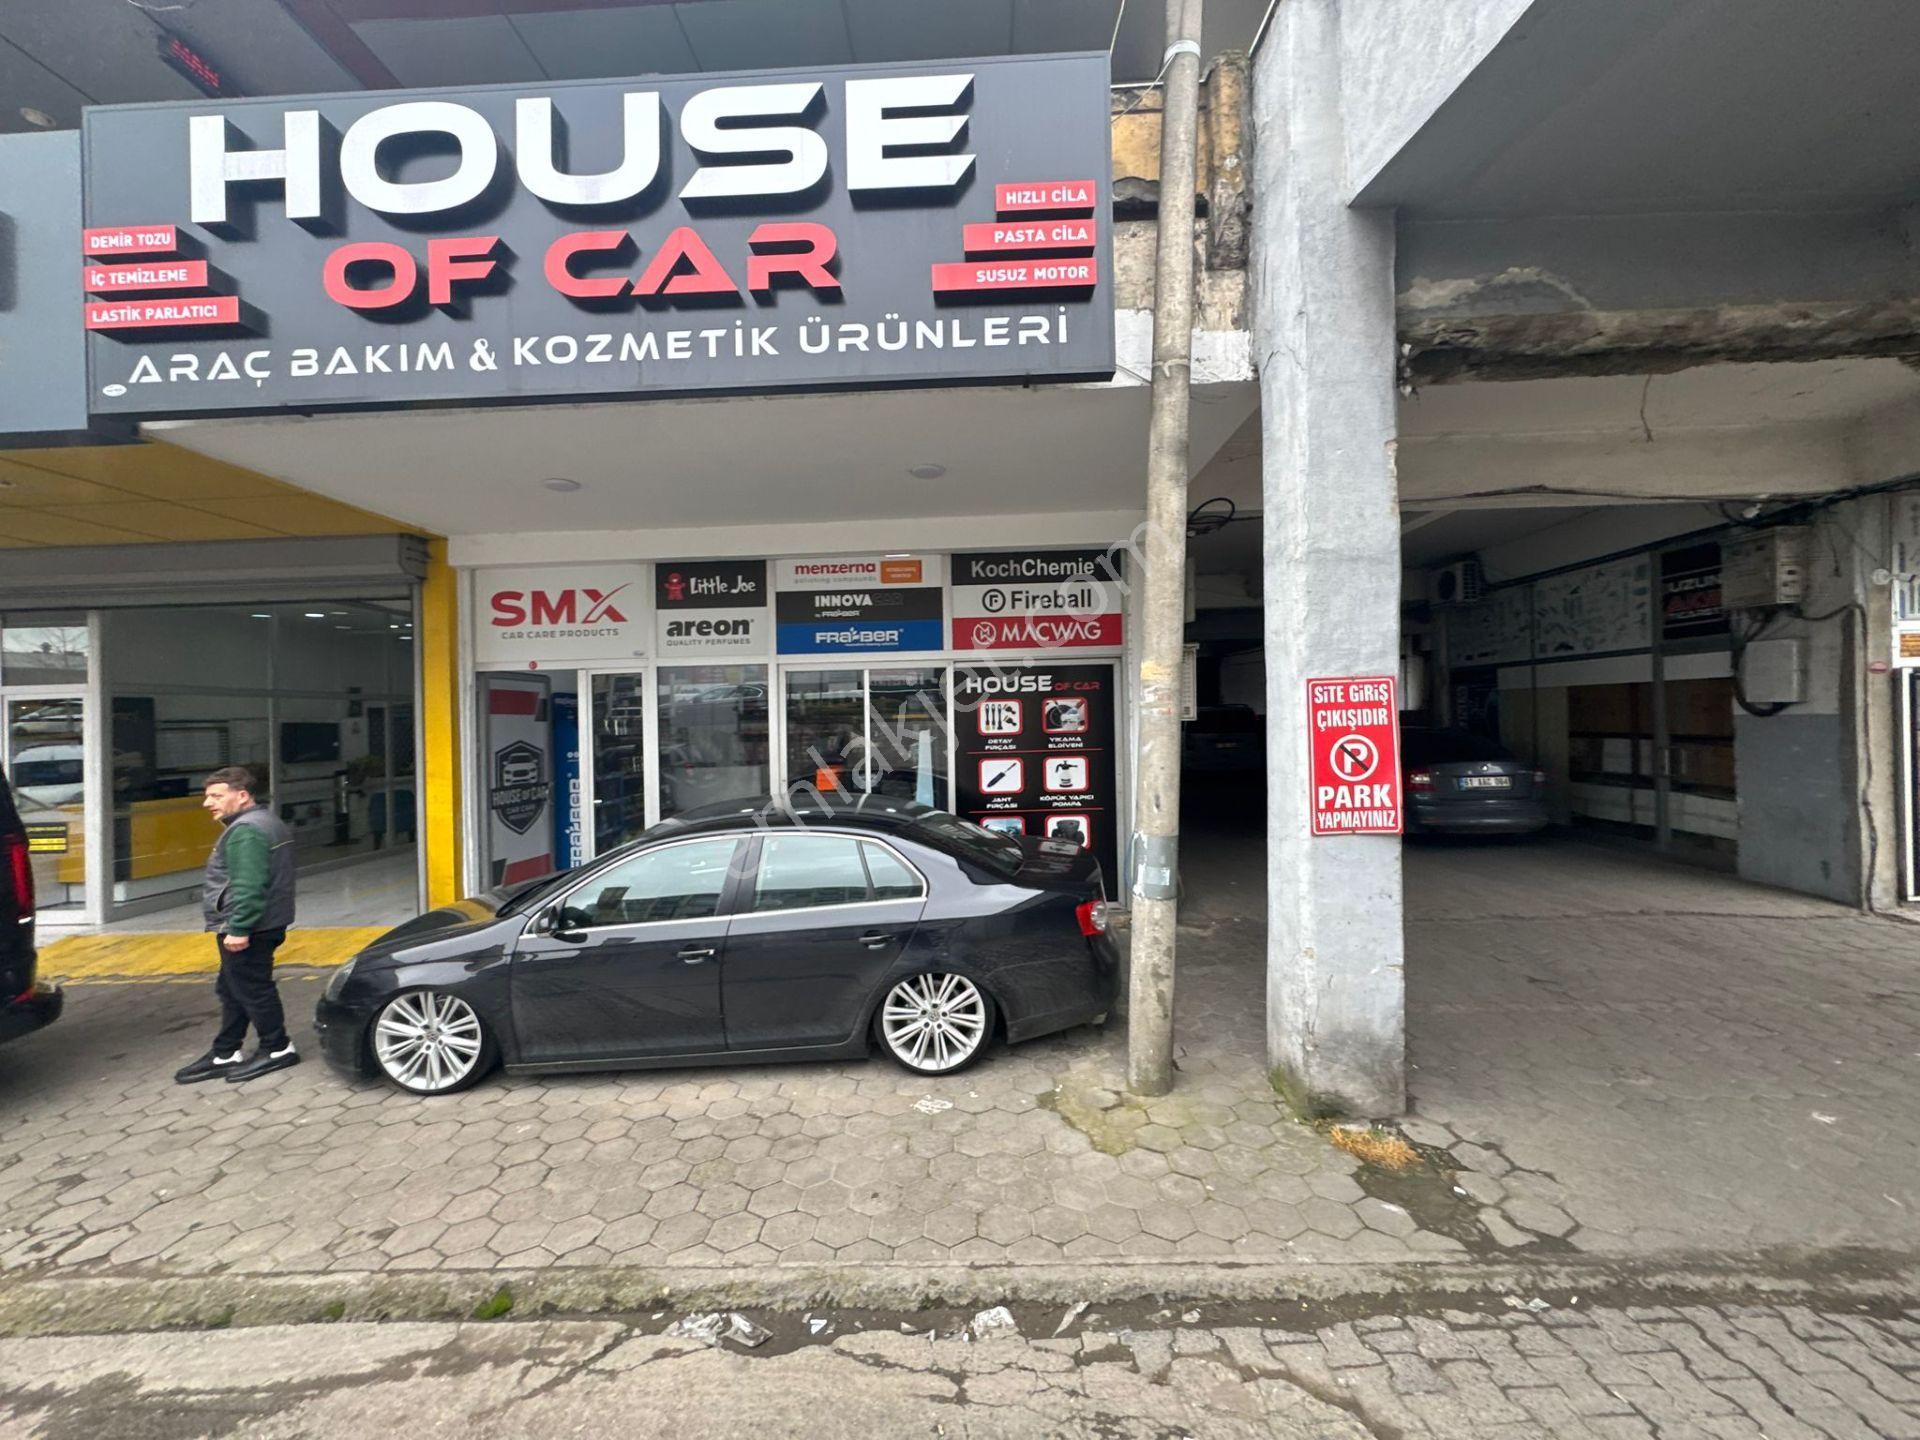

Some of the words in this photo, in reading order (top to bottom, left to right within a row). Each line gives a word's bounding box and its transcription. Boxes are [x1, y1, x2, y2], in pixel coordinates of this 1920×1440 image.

[190, 73, 976, 222] HOUSE
[1006, 190, 1046, 204] HIZLI
[1051, 186, 1088, 203] CİLA
[91, 232, 133, 249] DEMİR
[136, 232, 171, 247] TOZU
[994, 229, 1046, 243] PASTA
[1051, 225, 1088, 241] CİLA
[323, 235, 499, 308] OF
[544, 222, 842, 297] CAR
[976, 268, 1027, 283] SUSUZ
[1033, 266, 1089, 280] MOTOR
[91, 270, 106, 286] İÇ
[109, 268, 188, 284] TEMİZLEME
[92, 306, 141, 322] LASTİK
[145, 305, 218, 320] PARLATICI
[128, 350, 271, 387] ARAÇ
[290, 341, 455, 377] BAKIM
[468, 338, 498, 371] &
[513, 320, 780, 366] KOZMETİK
[799, 306, 1068, 354] ÜRÜNLERİ
[794, 562, 876, 575] menzerna
[690, 575, 728, 595] Little
[730, 574, 756, 594] Joe
[490, 582, 635, 627] SMX
[1011, 588, 1092, 610] Fireball
[501, 630, 525, 640] CAR
[526, 629, 557, 639] CARE
[558, 627, 619, 638] PRODUCTS
[666, 618, 750, 637] areon
[1001, 621, 1101, 642] MACWAG
[666, 638, 703, 647] QUALITY
[705, 637, 751, 646] PERFUMES
[966, 675, 1053, 694] HOUSE
[1054, 681, 1072, 691] OF
[1074, 681, 1101, 690] CAR
[1316, 707, 1389, 732] ÇIKIŞIDIR
[1317, 784, 1393, 810] PARK
[1317, 810, 1396, 829] YAPMAYINIZ
